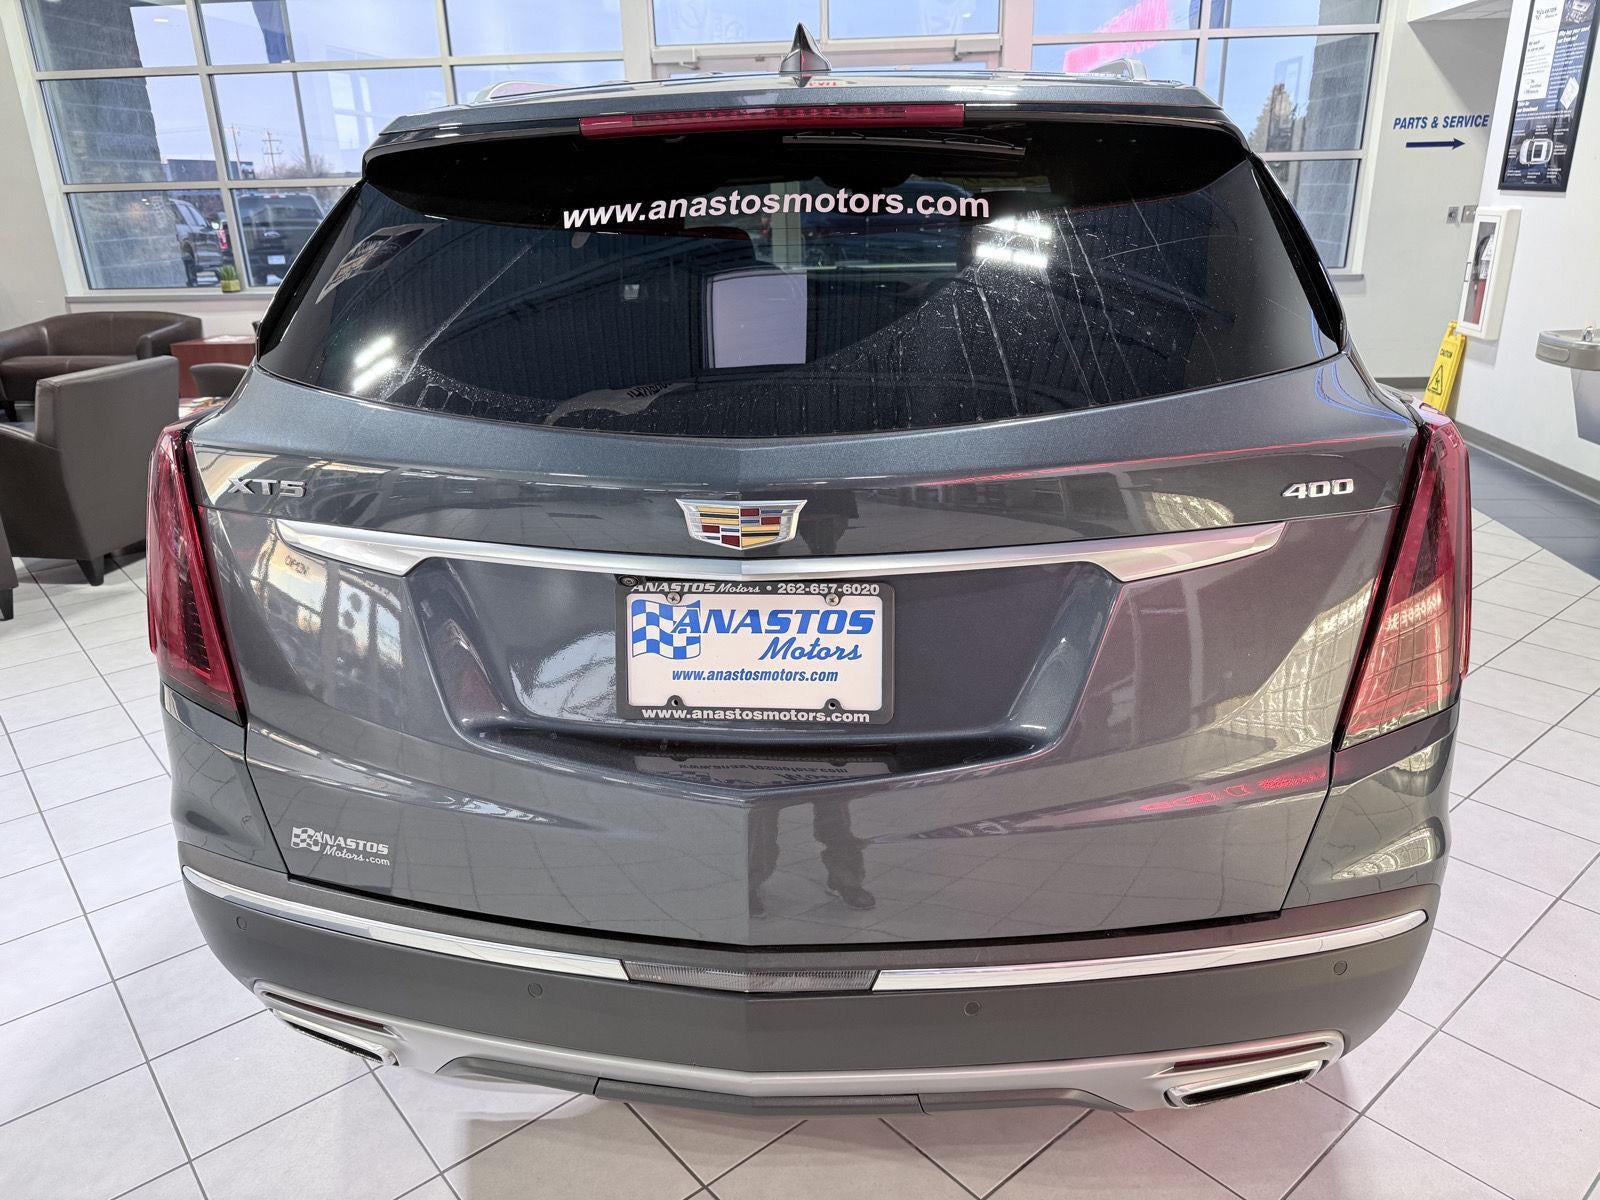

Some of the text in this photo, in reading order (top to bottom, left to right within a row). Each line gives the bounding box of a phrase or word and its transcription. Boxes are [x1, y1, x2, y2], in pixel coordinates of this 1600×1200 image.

[1393, 114, 1490, 130] PARTS & SERVICE
[563, 188, 989, 229] www.anastosmotors.com
[227, 477, 307, 498] XT5
[1282, 478, 1354, 499] 400
[631, 582, 880, 595] ANASTOS Motors 262-657-6020
[671, 608, 876, 635] ANASTOS
[758, 636, 862, 661] Motors
[672, 668, 839, 683] www.anastosmotors.com
[642, 708, 870, 723] www.anastosmotors.com
[311, 831, 389, 855] ANASTOS
[323, 845, 391, 866] Motors.com
